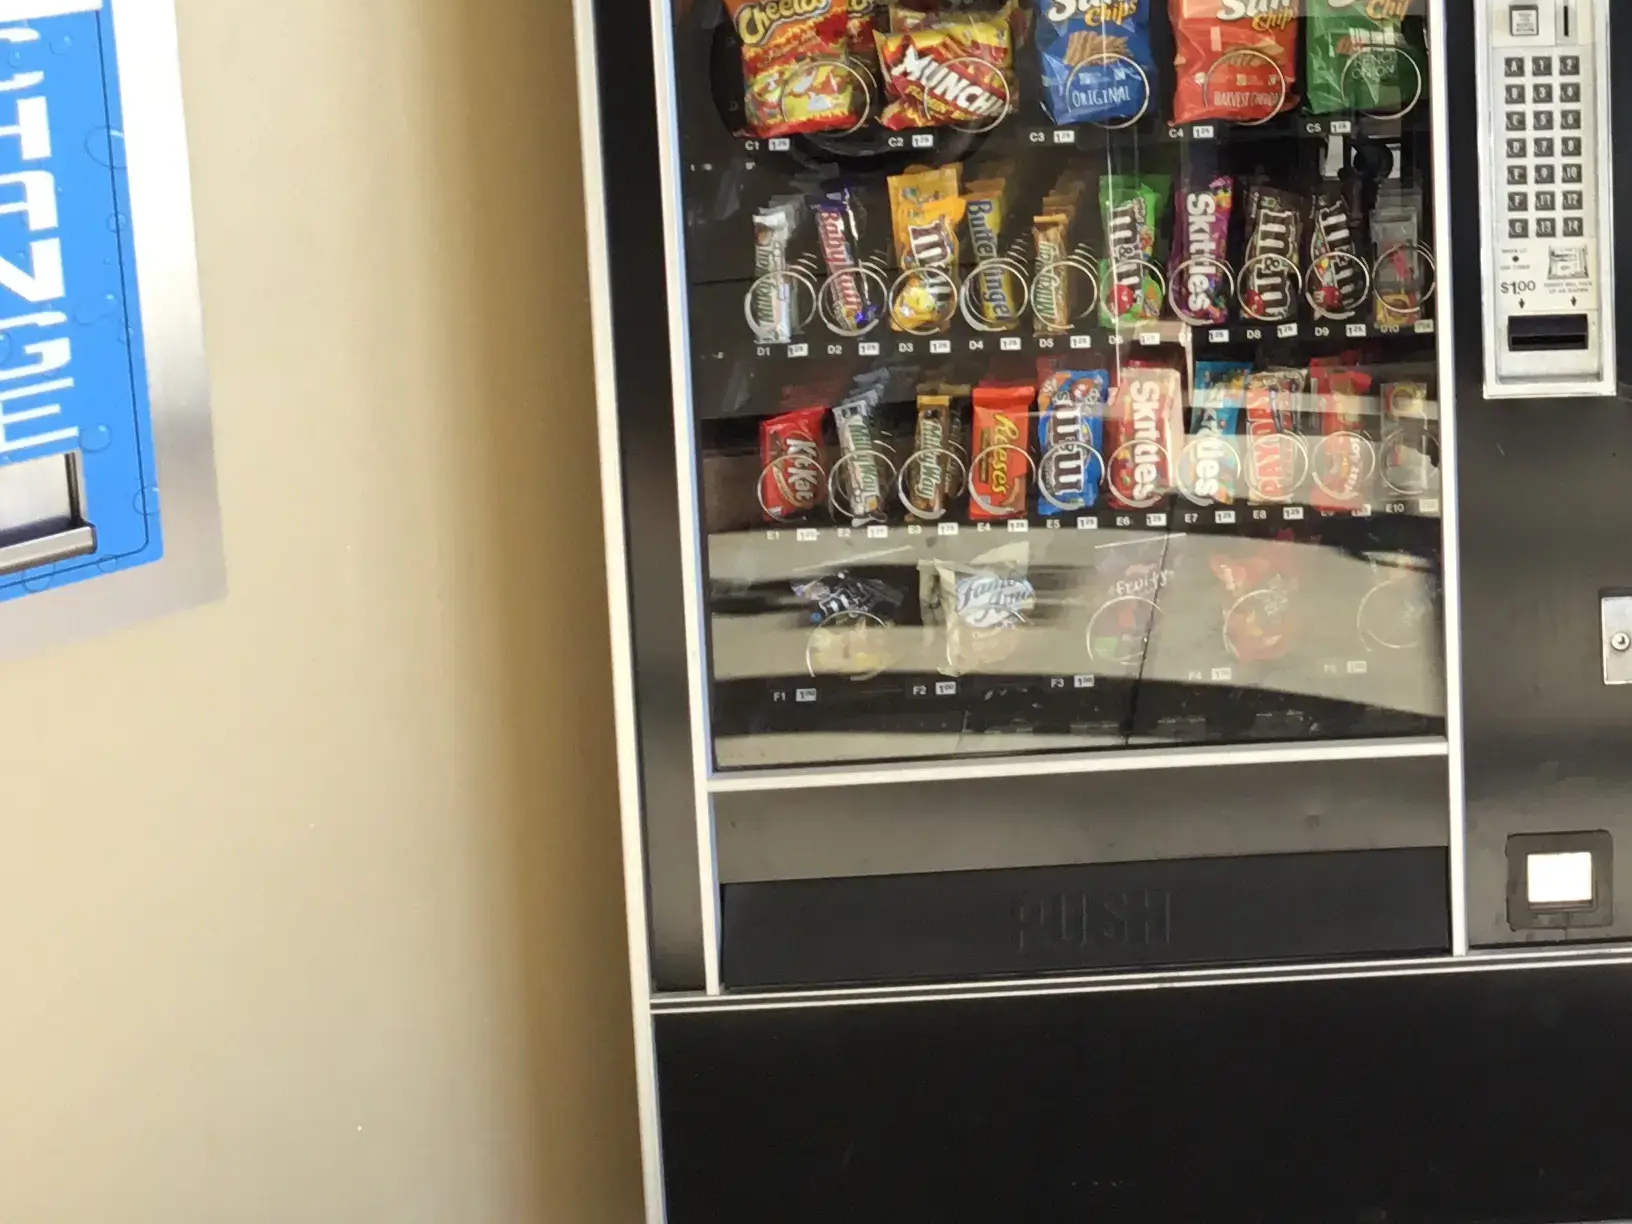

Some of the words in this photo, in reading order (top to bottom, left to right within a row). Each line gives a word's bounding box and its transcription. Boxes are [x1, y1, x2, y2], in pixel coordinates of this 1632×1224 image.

[1251, 7, 1296, 31] Chip
[1071, 86, 1132, 108] ORIGINAL
[1168, 128, 1184, 138] C4
[1306, 123, 1321, 133] C5
[888, 137, 904, 147] C2
[1029, 132, 1045, 142] C3
[745, 140, 760, 151] C1
[1186, 192, 1217, 313] Skittles
[1034, 273, 1057, 319] Milky
[755, 281, 776, 325] Milky
[1246, 329, 1261, 339] D8
[1314, 326, 1330, 337] D9
[898, 342, 914, 352] D3
[968, 340, 984, 350] D4
[1039, 337, 1054, 348] D5
[757, 346, 770, 357] D1
[827, 344, 843, 355] D2
[1129, 380, 1160, 502] Skittles
[990, 413, 1020, 496] Reese's
[786, 467, 817, 502] Kat
[916, 464, 941, 499] Way
[1184, 513, 1198, 523] E7
[1046, 519, 1060, 529] E5
[1051, 678, 1064, 688] F3
[913, 685, 927, 695] F2
[773, 691, 786, 702] F1
